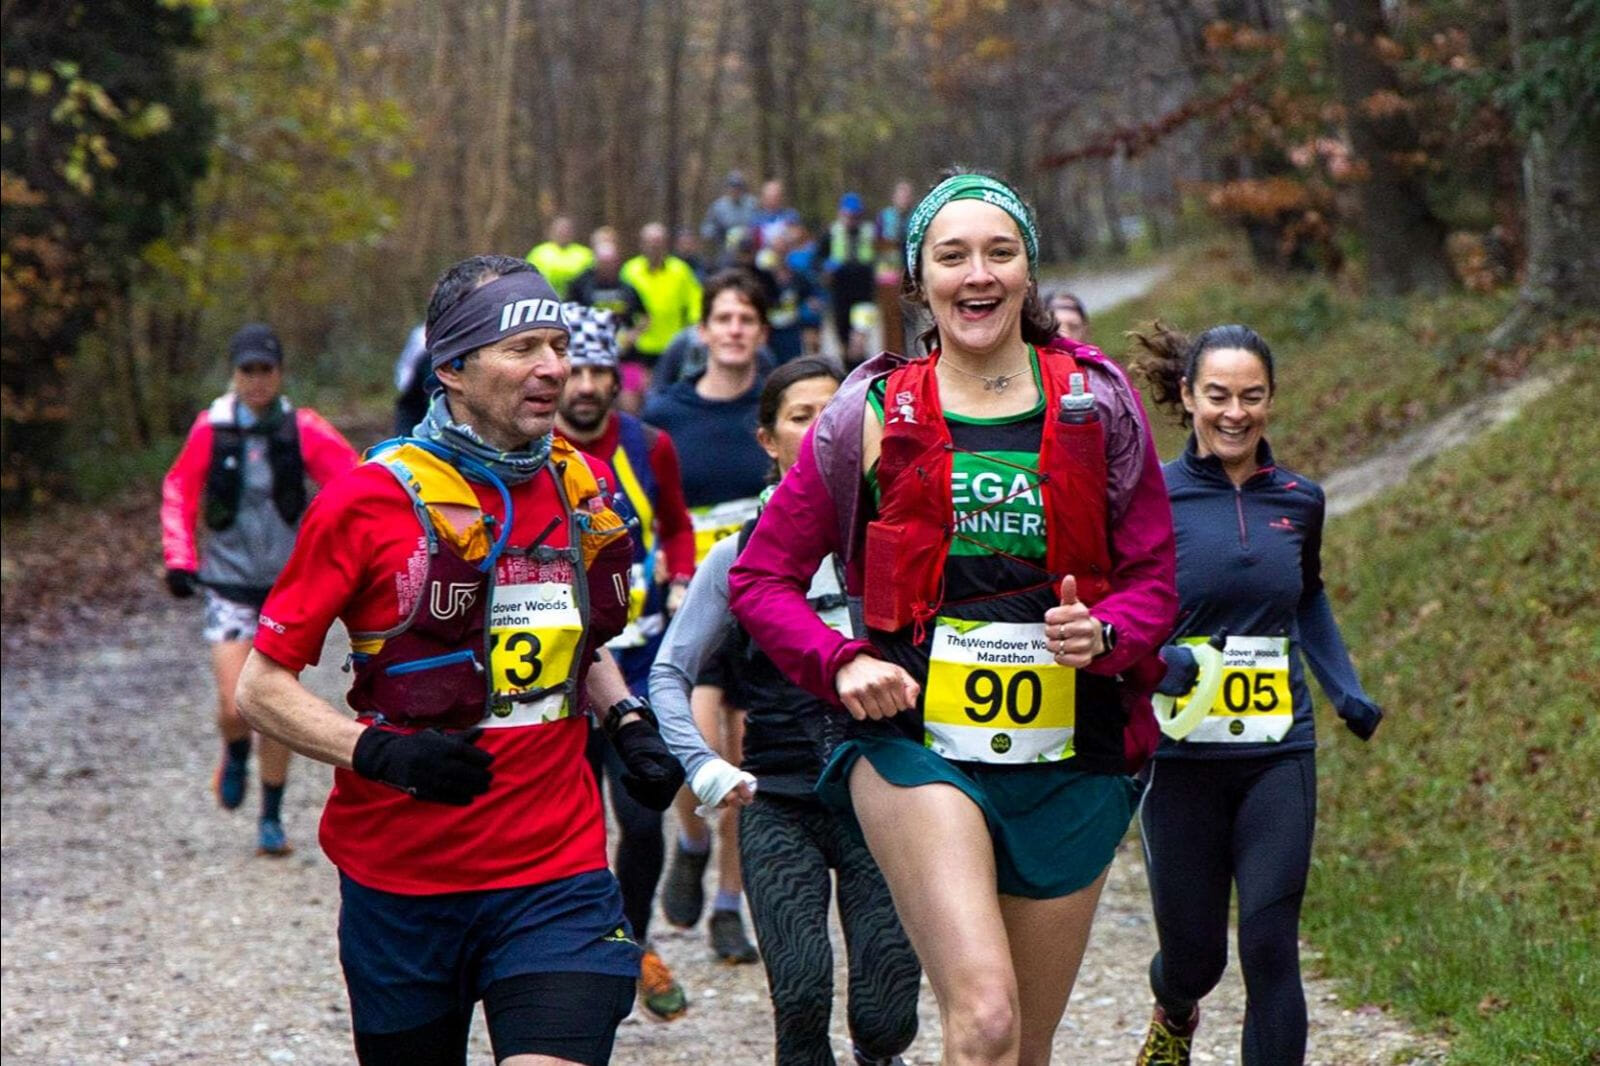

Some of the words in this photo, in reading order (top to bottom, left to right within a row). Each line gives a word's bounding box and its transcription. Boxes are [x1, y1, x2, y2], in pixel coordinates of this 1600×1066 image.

[951, 472, 1044, 507] EGA
[492, 603, 522, 613] dover
[525, 600, 567, 611] Woods
[491, 615, 530, 626] rathon
[946, 634, 966, 647] The
[966, 637, 1028, 651] Wendover
[1030, 638, 1047, 650] Wo
[977, 651, 1035, 664] Marathon
[964, 669, 1042, 724] 90
[1223, 671, 1279, 713] 05
